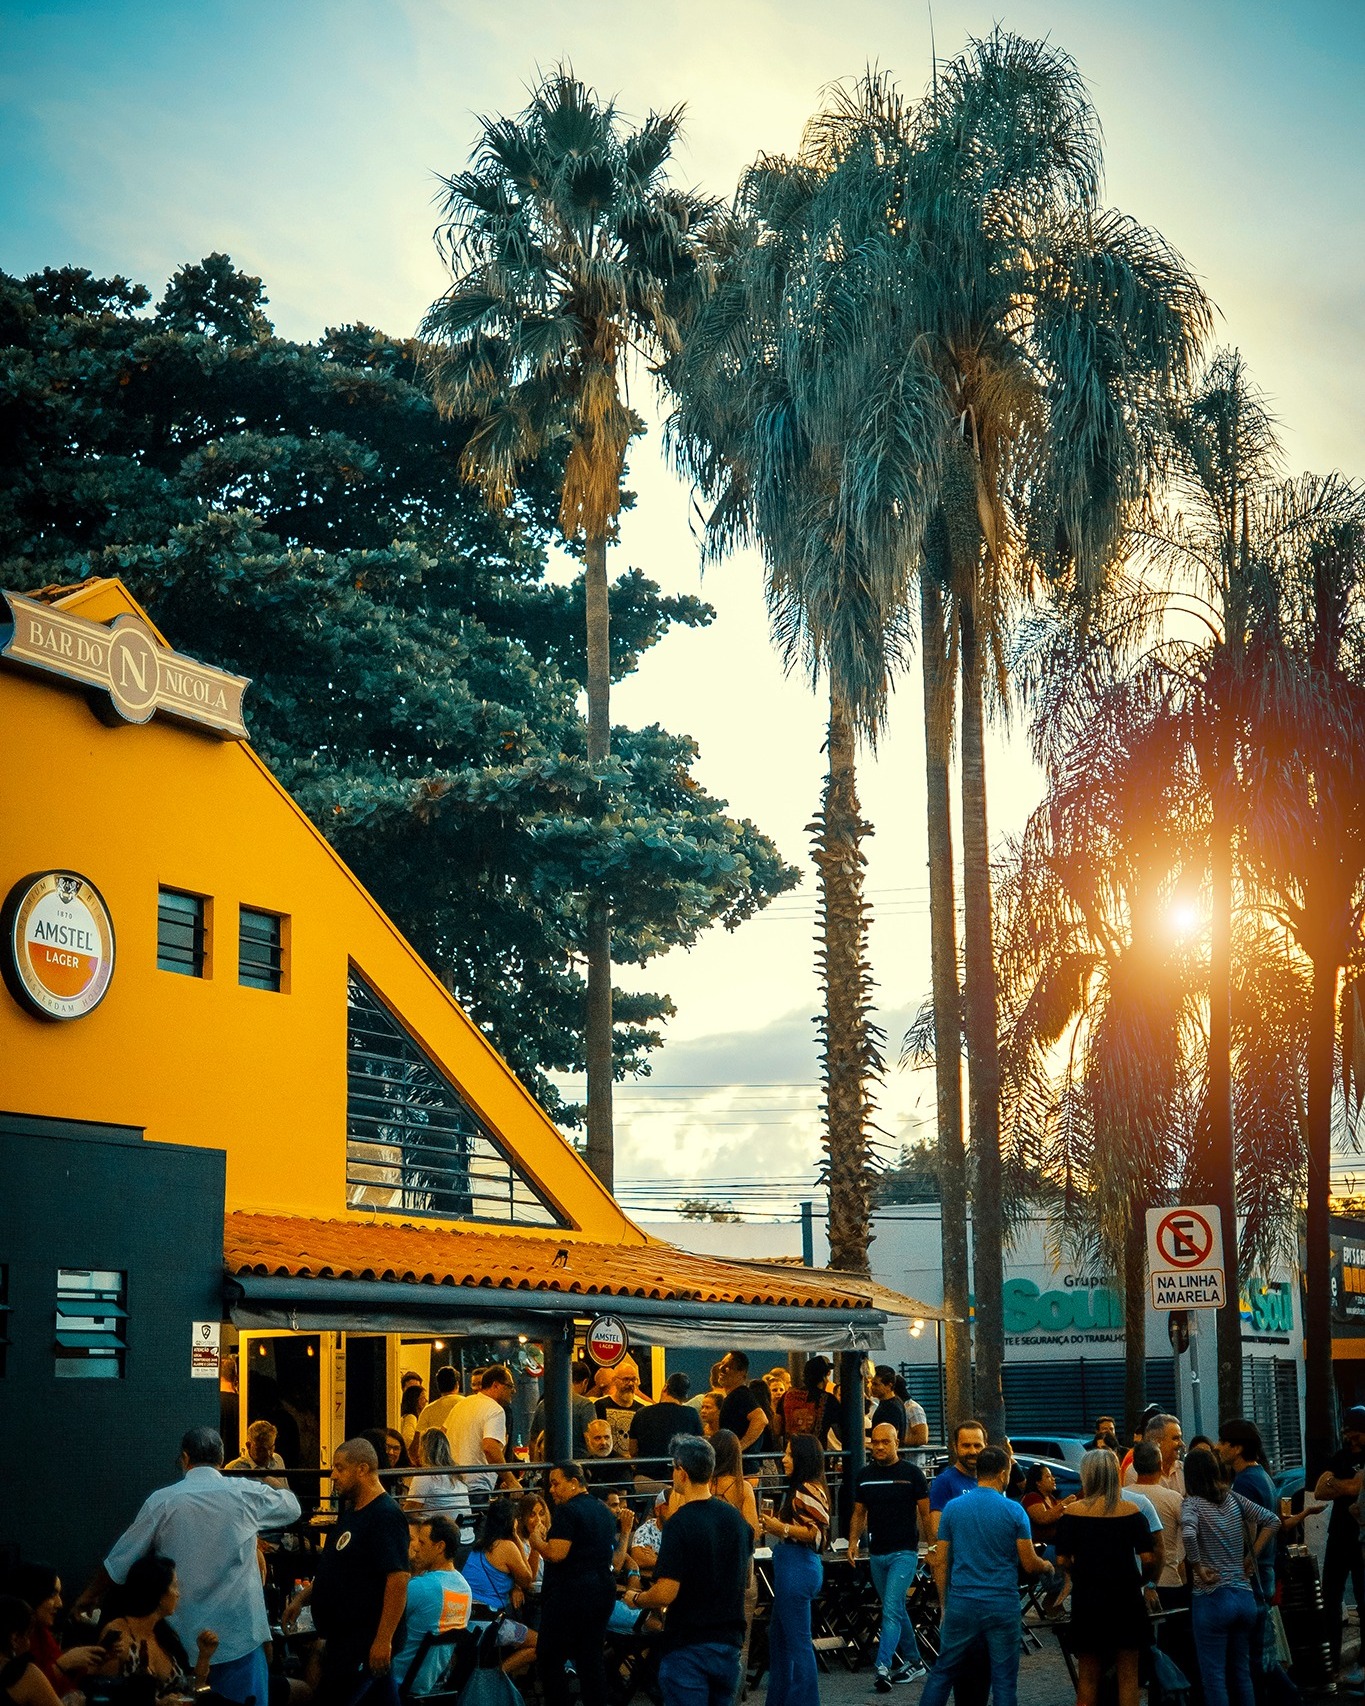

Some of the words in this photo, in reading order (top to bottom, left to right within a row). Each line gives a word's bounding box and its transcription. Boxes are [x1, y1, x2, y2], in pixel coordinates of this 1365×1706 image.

[29, 620, 73, 657] BAR
[77, 637, 103, 667] DO
[119, 644, 148, 693] N
[165, 669, 228, 711] NICOLA
[56, 910, 73, 920] 1870
[34, 920, 93, 951] AMSTEL
[45, 951, 79, 969] LAGER
[1063, 1274, 1108, 1288] Grupo
[1157, 1276, 1176, 1288] NA
[1179, 1274, 1218, 1288] LINHA
[1157, 1289, 1220, 1304] AMARELA
[595, 1333, 620, 1342] AMSTEL
[1015, 1337, 1020, 1345] E
[1021, 1335, 1069, 1346] SEGURANÇA
[1070, 1335, 1084, 1344] DO
[1085, 1333, 1126, 1343] TRABALHO
